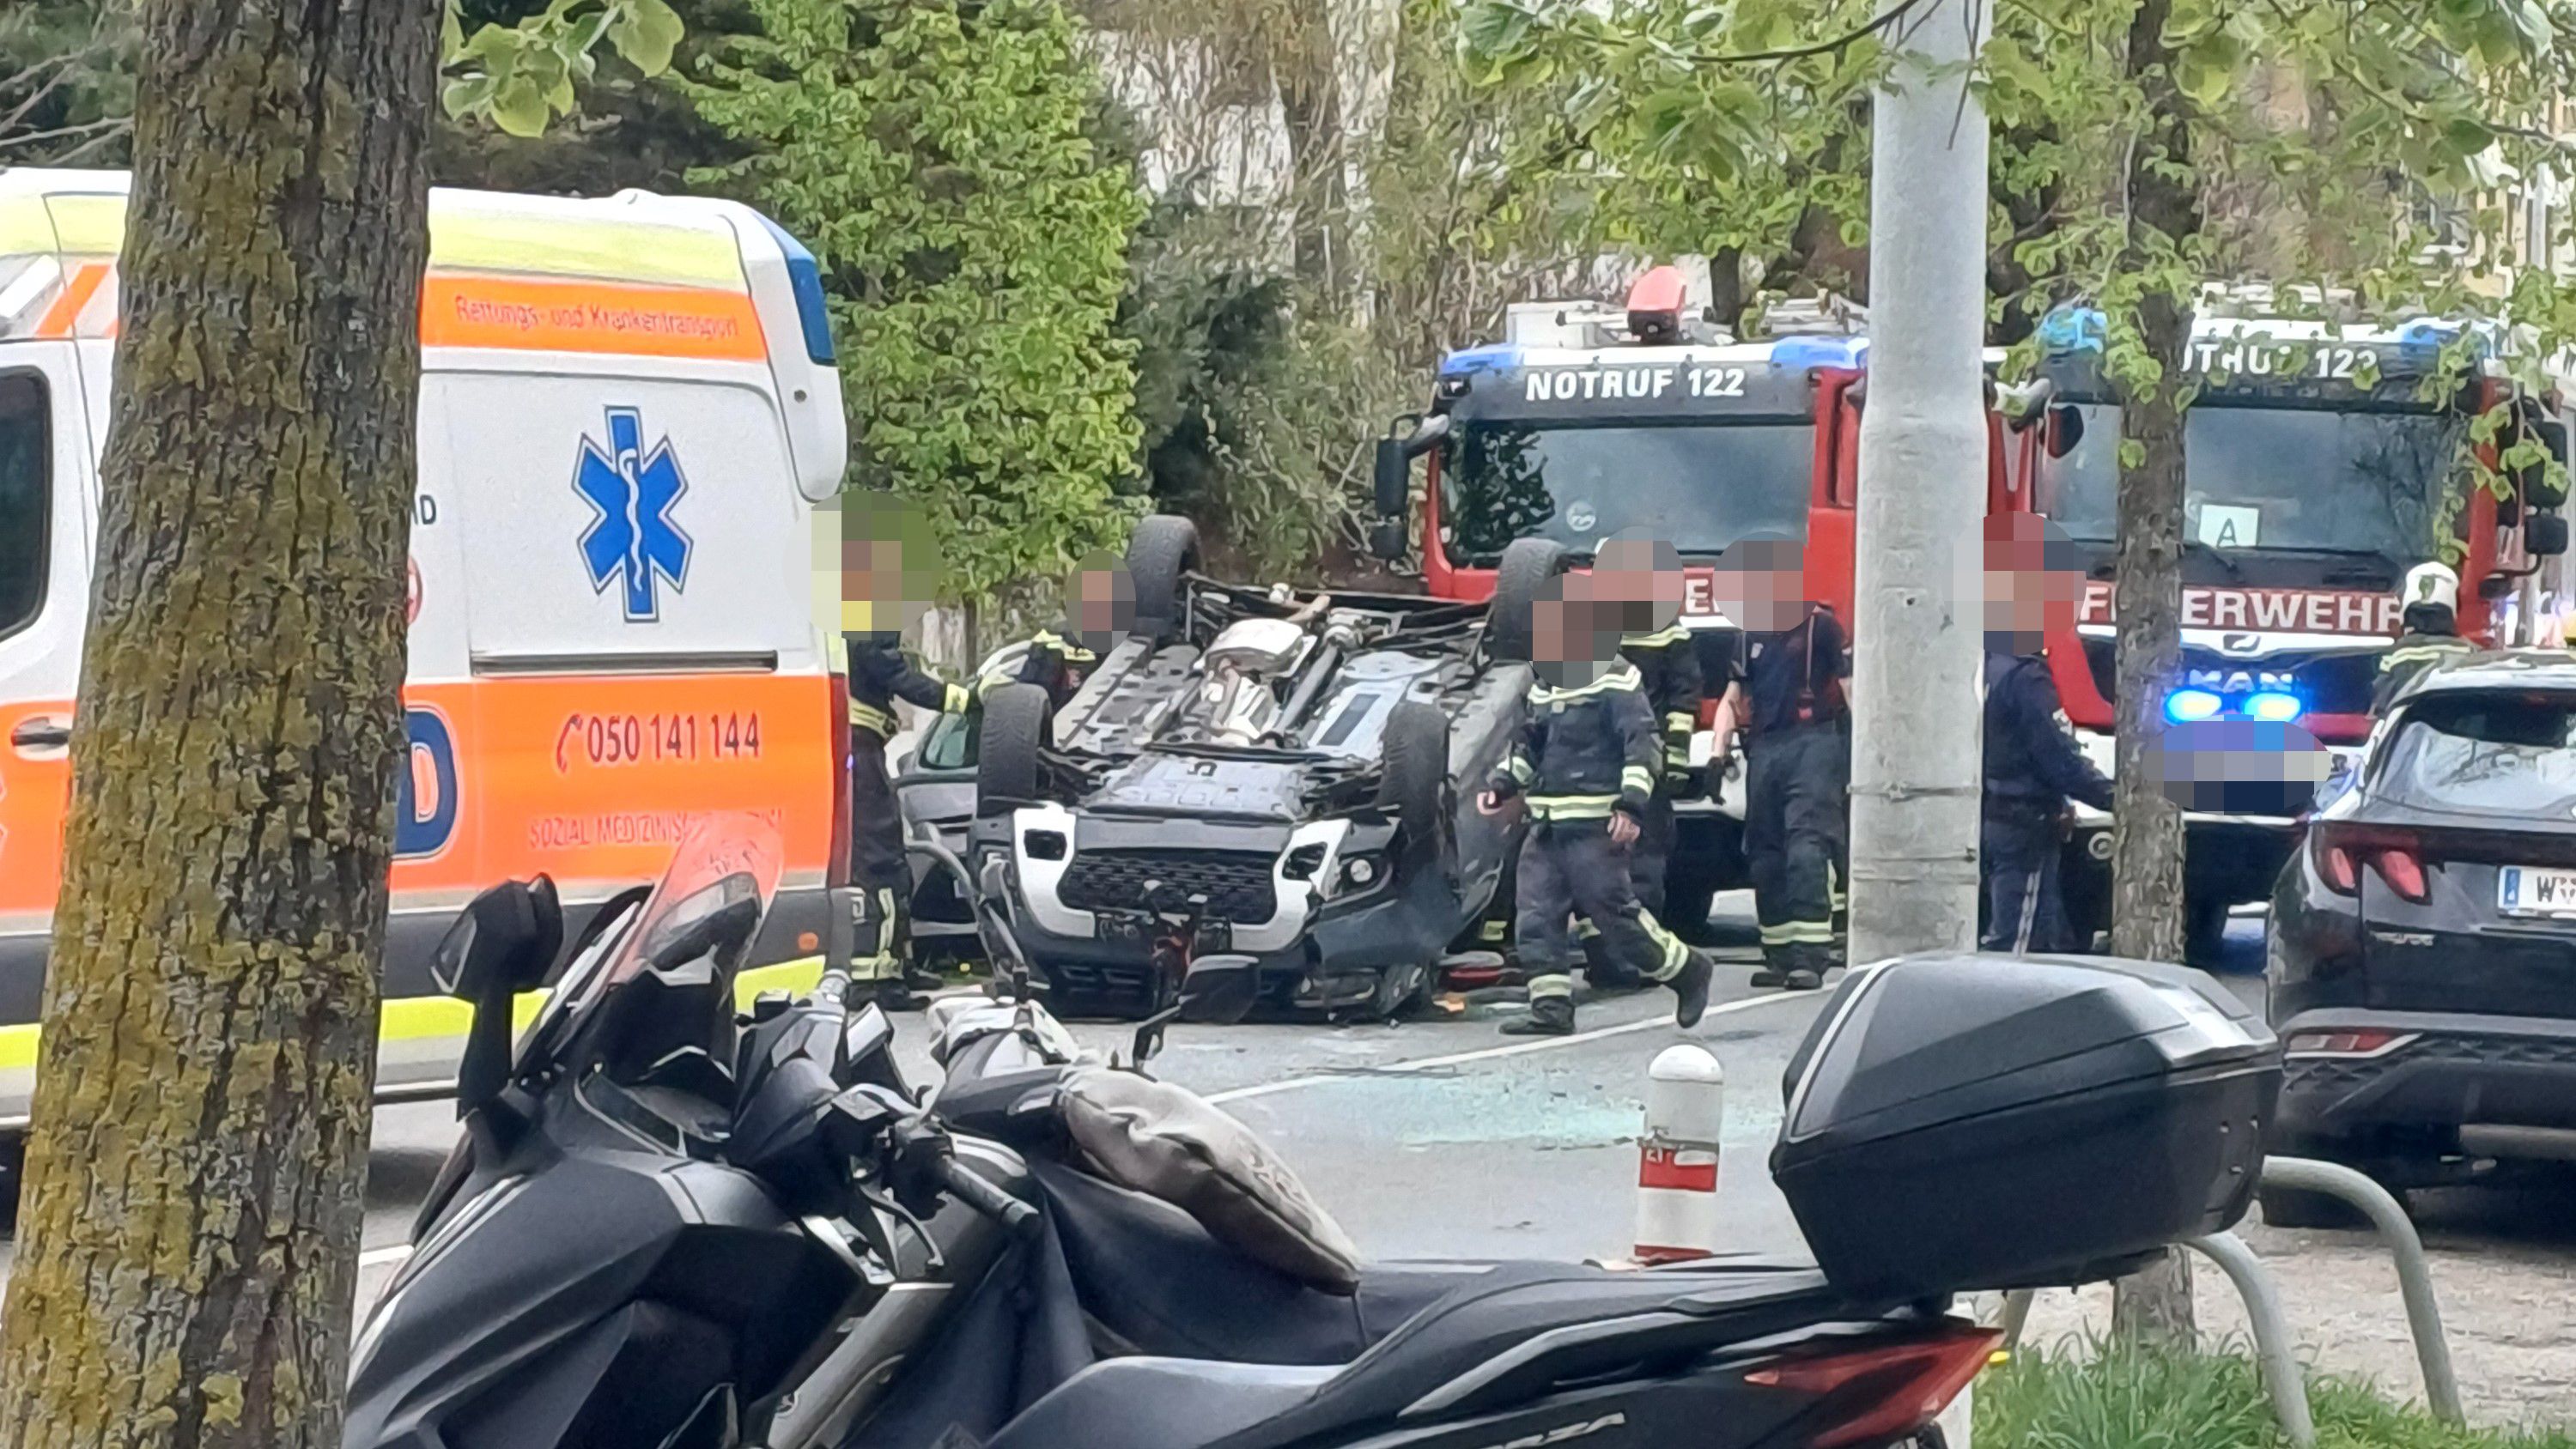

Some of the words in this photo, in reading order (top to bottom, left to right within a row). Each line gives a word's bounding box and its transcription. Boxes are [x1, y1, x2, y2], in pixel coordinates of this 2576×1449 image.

[550, 302, 585, 328] und
[1526, 369, 1673, 401] NOTRUF
[1688, 368, 1745, 397] 122
[2216, 518, 2237, 549] A
[587, 715, 640, 762] 050
[650, 713, 696, 760] 141
[711, 711, 759, 758] 144
